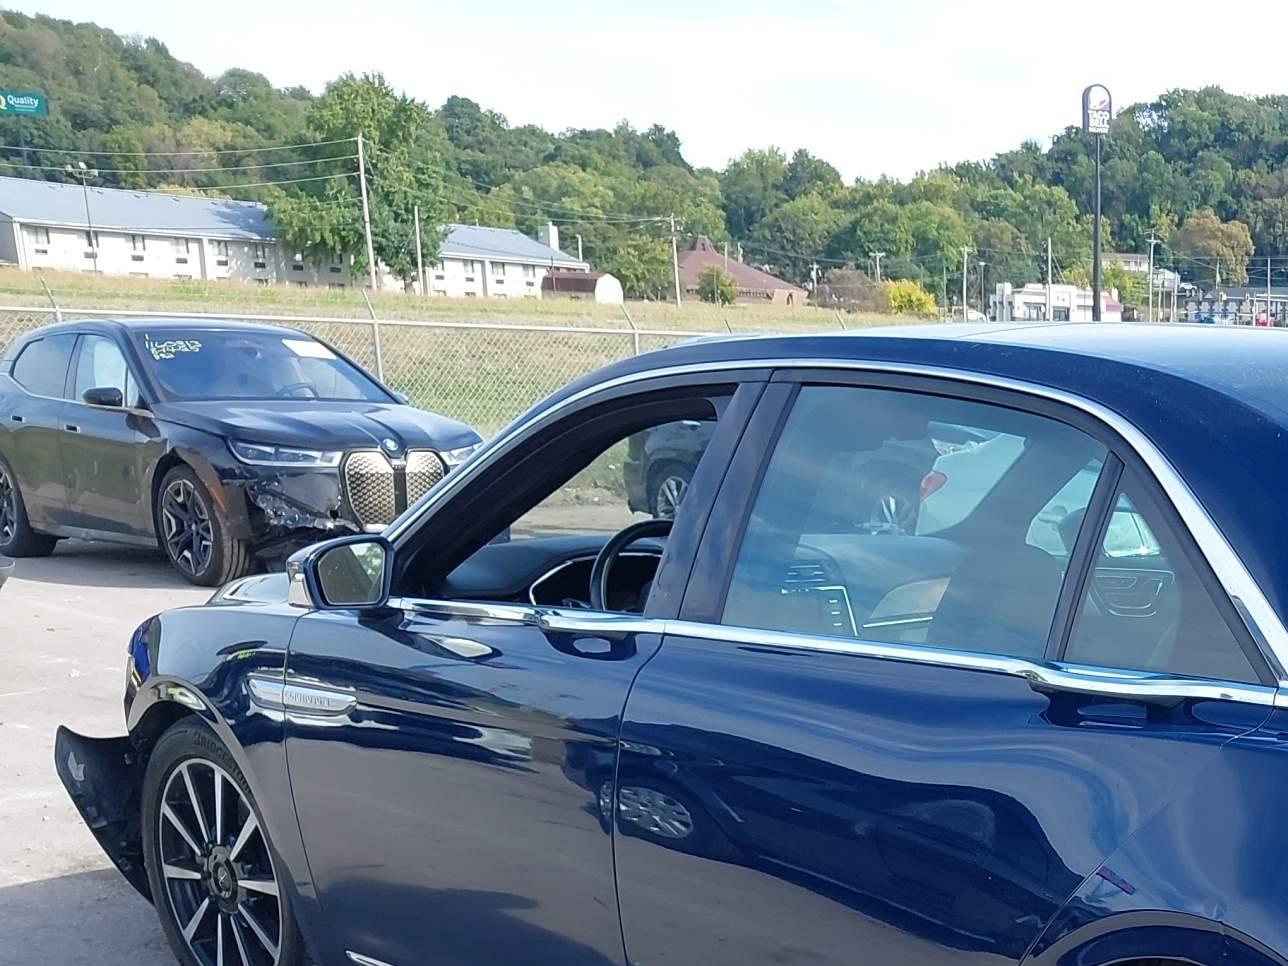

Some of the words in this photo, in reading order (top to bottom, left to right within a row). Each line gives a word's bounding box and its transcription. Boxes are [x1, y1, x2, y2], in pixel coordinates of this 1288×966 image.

[7, 94, 39, 108] Quality
[1088, 109, 1110, 120] TACO
[1089, 118, 1110, 128] BELL
